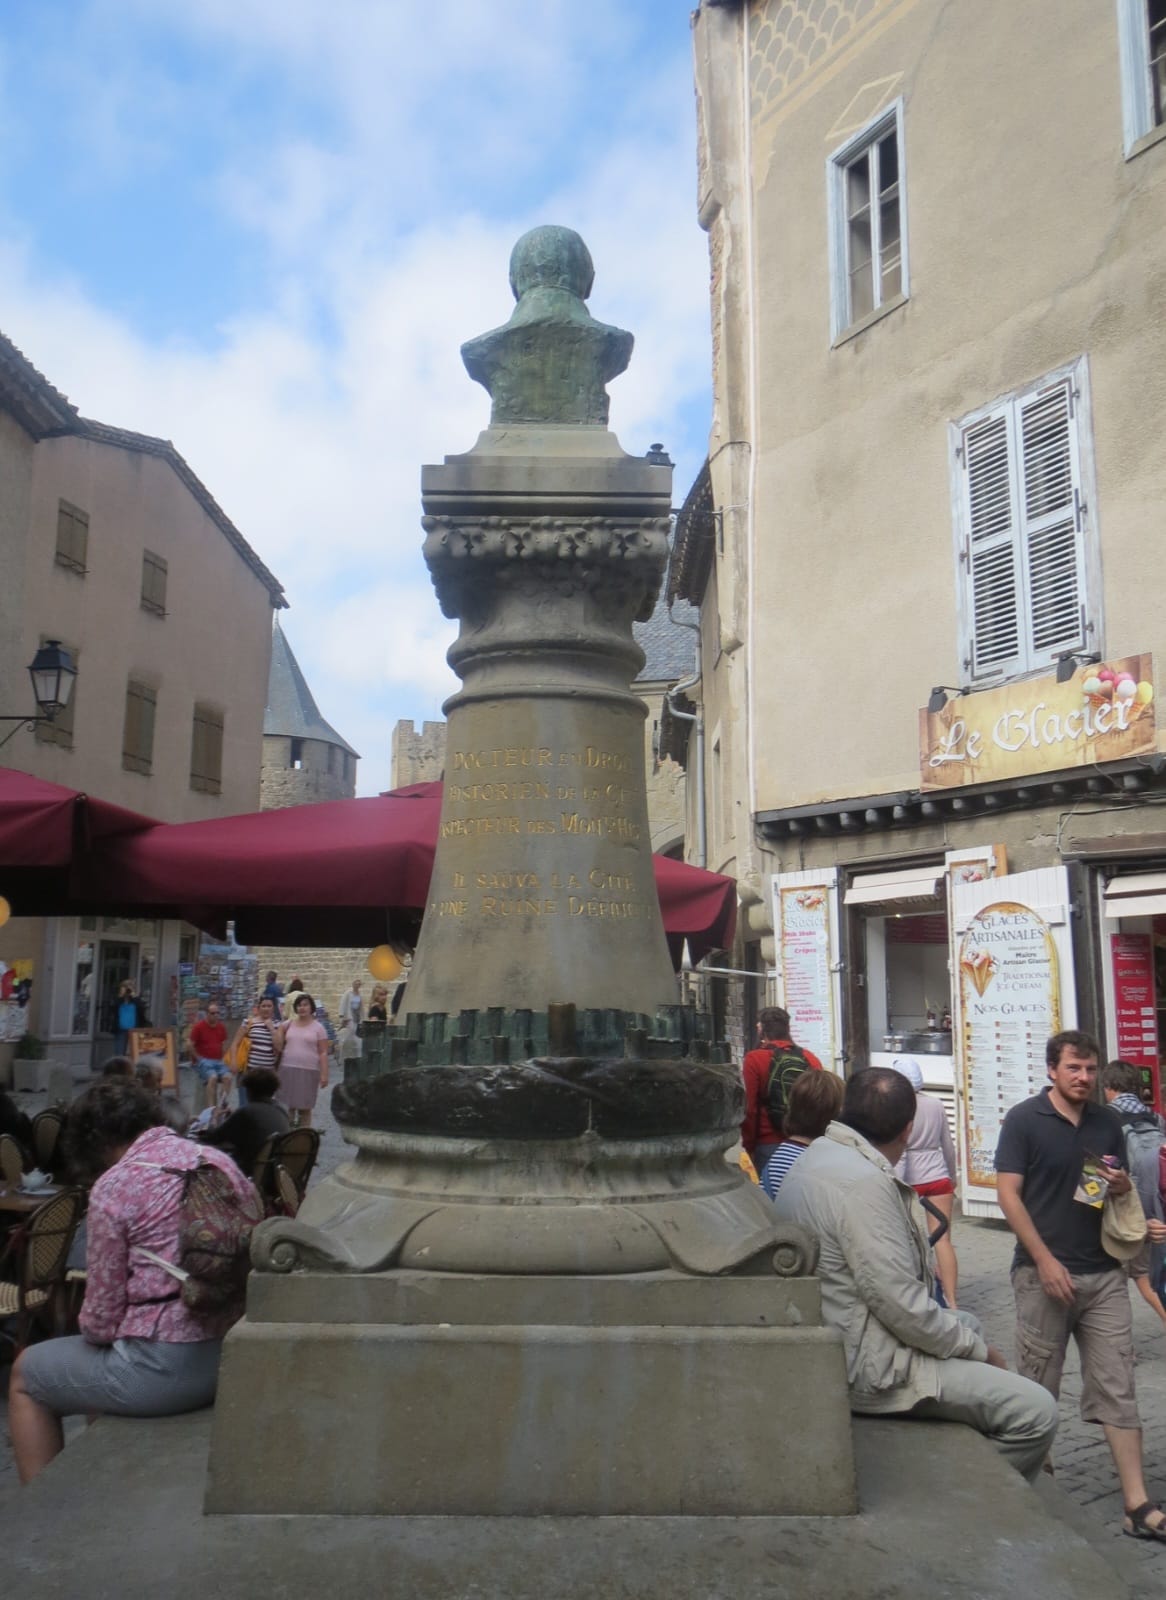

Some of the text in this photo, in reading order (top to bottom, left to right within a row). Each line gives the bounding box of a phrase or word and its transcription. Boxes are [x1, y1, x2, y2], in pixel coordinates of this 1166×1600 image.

[929, 696, 1134, 767] Le Glacier
[981, 914, 1029, 930] GLACES
[969, 928, 1045, 945] ARTISANALES
[974, 1002, 1047, 1015] NOS GLACES
